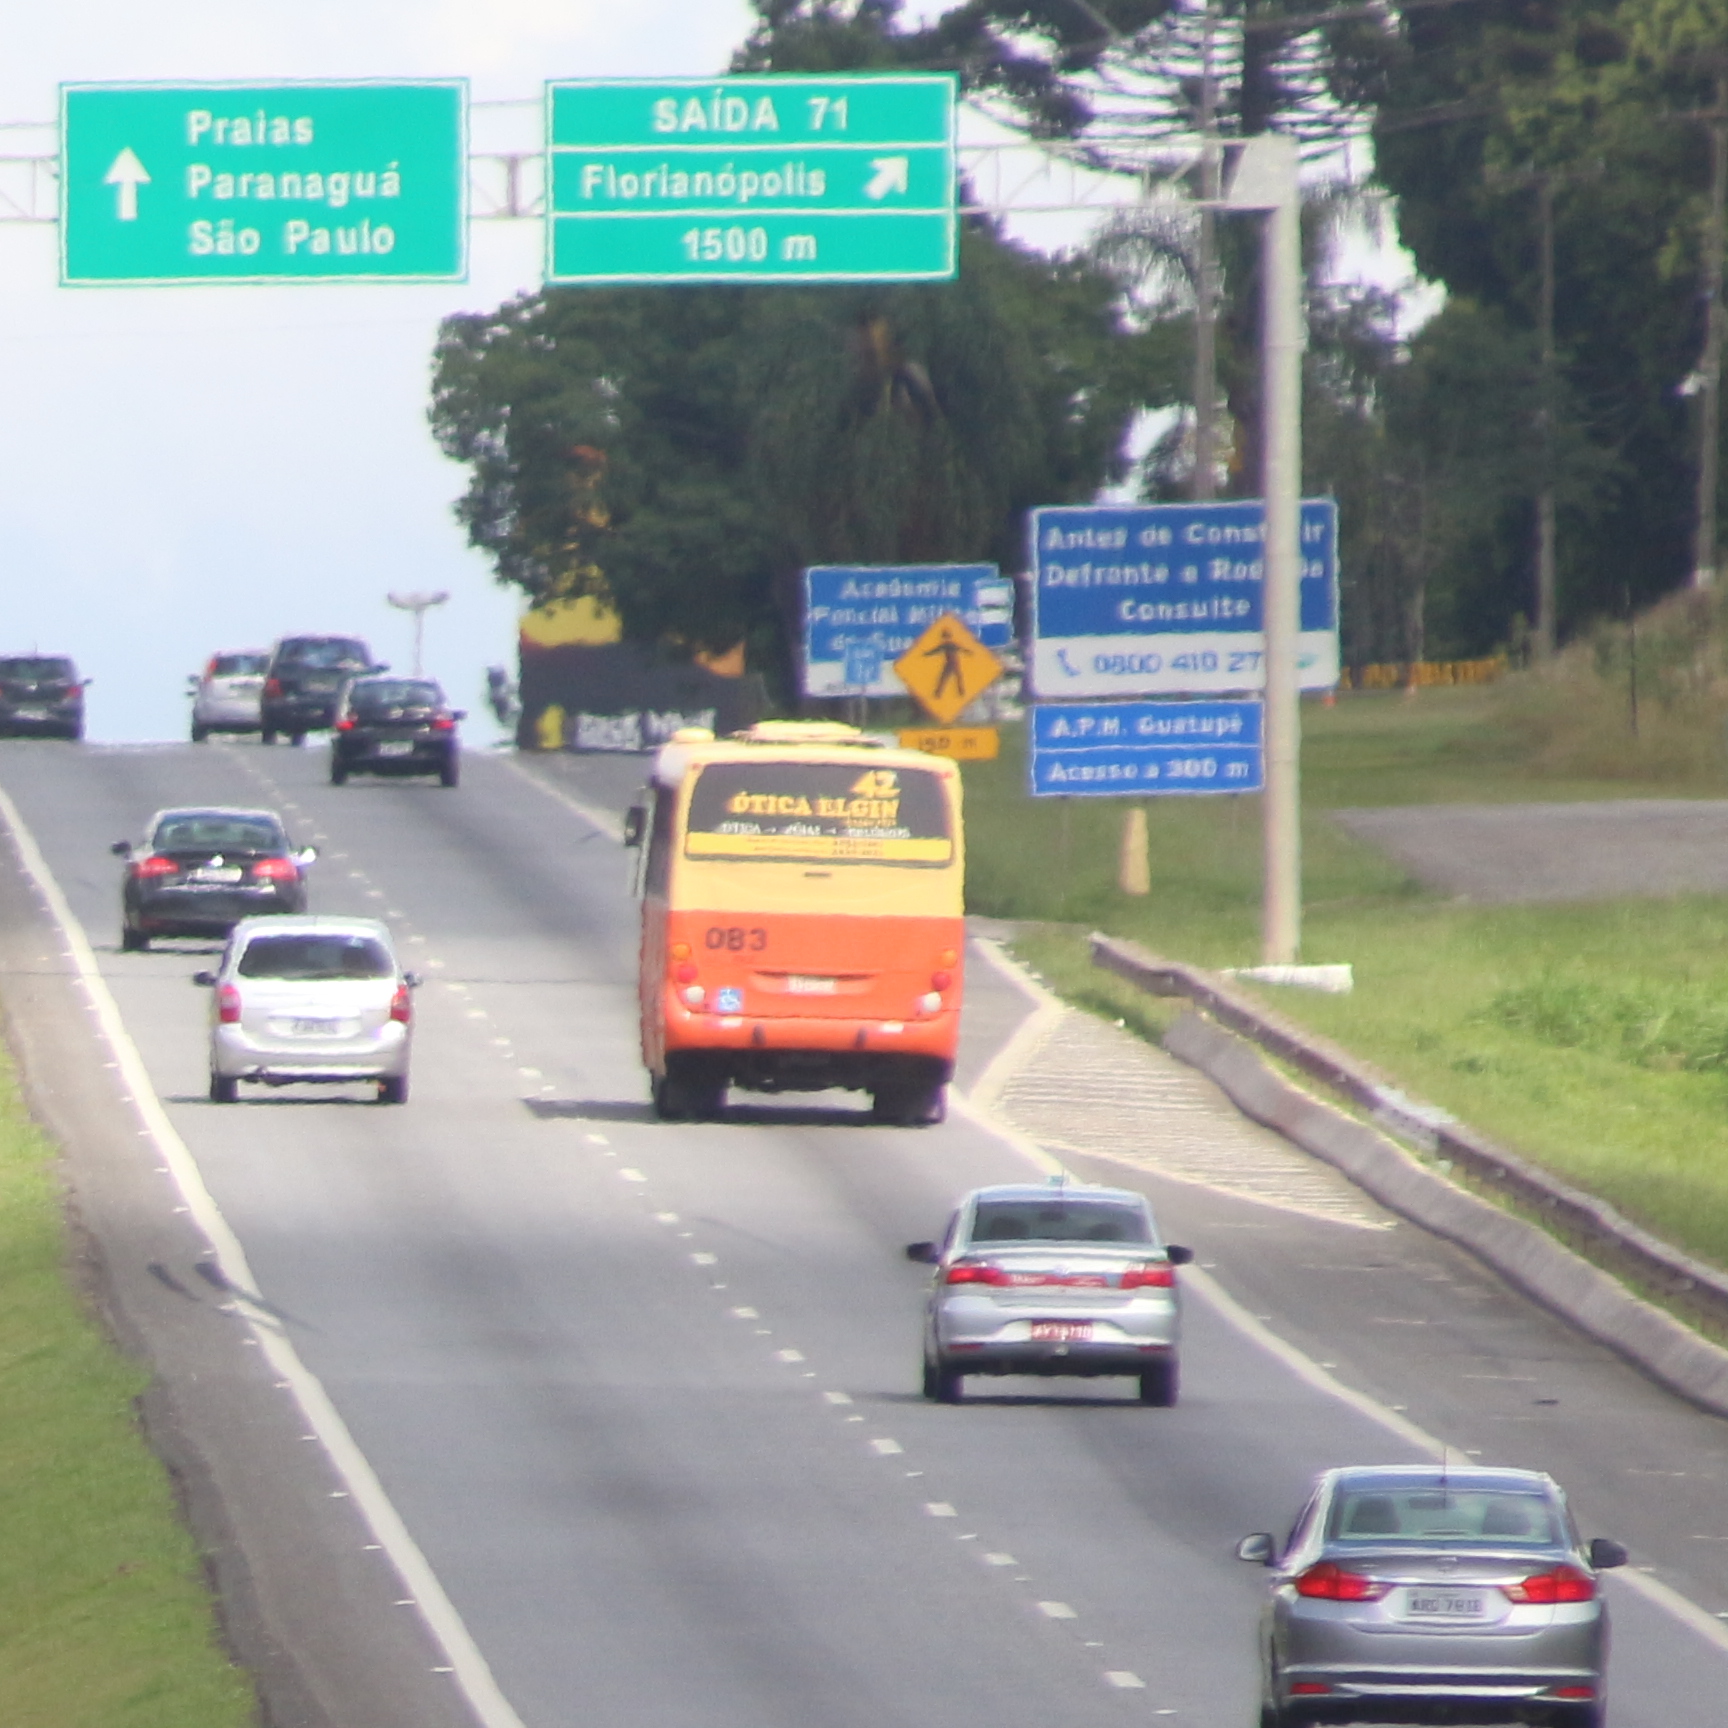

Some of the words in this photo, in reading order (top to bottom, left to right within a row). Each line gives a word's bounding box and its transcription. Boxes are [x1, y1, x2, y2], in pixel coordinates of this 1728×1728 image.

[187, 109, 314, 146] Praias
[652, 87, 779, 132] SAÍDA
[807, 96, 848, 130] 71
[187, 159, 401, 208] Paranaguá
[580, 161, 826, 203] Florianópolis
[189, 218, 261, 255] São
[285, 217, 395, 255] Paulo
[681, 226, 768, 261] 1500
[781, 234, 817, 261] m
[1047, 526, 1128, 549] Antes
[1185, 520, 1326, 545] Constir
[1119, 597, 1251, 621] Consulte
[1094, 652, 1163, 675] 0800
[729, 791, 813, 817] ÓTICA
[819, 798, 900, 818] ELGIN
